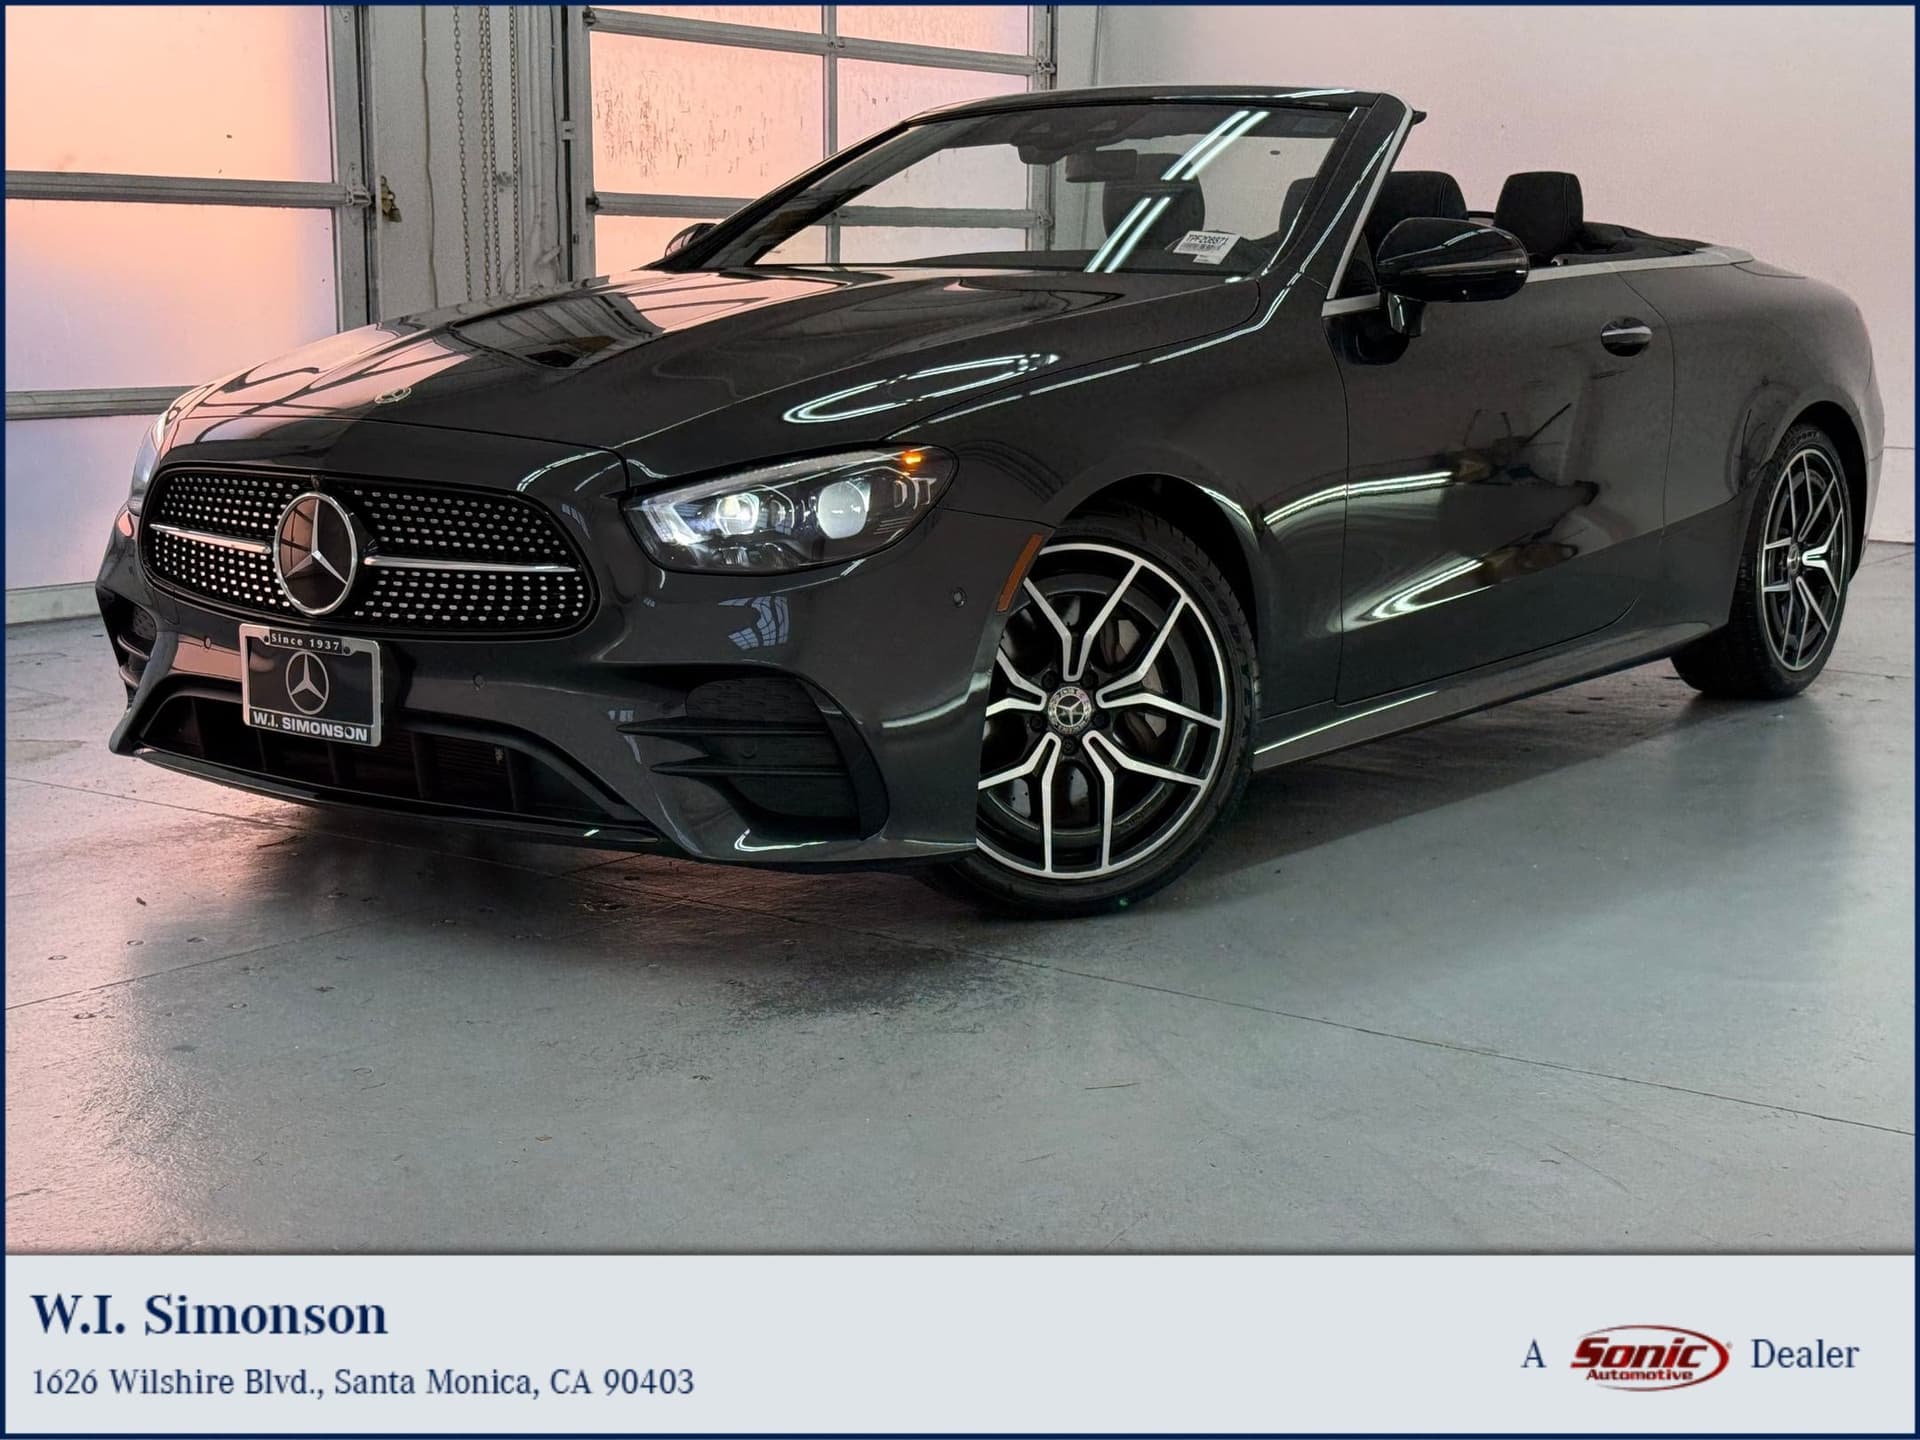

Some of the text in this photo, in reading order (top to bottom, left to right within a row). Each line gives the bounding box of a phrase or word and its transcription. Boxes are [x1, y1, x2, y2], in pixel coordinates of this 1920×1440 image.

[271, 632, 340, 651] Since 1937
[253, 711, 368, 742] W.I. SIMONSON
